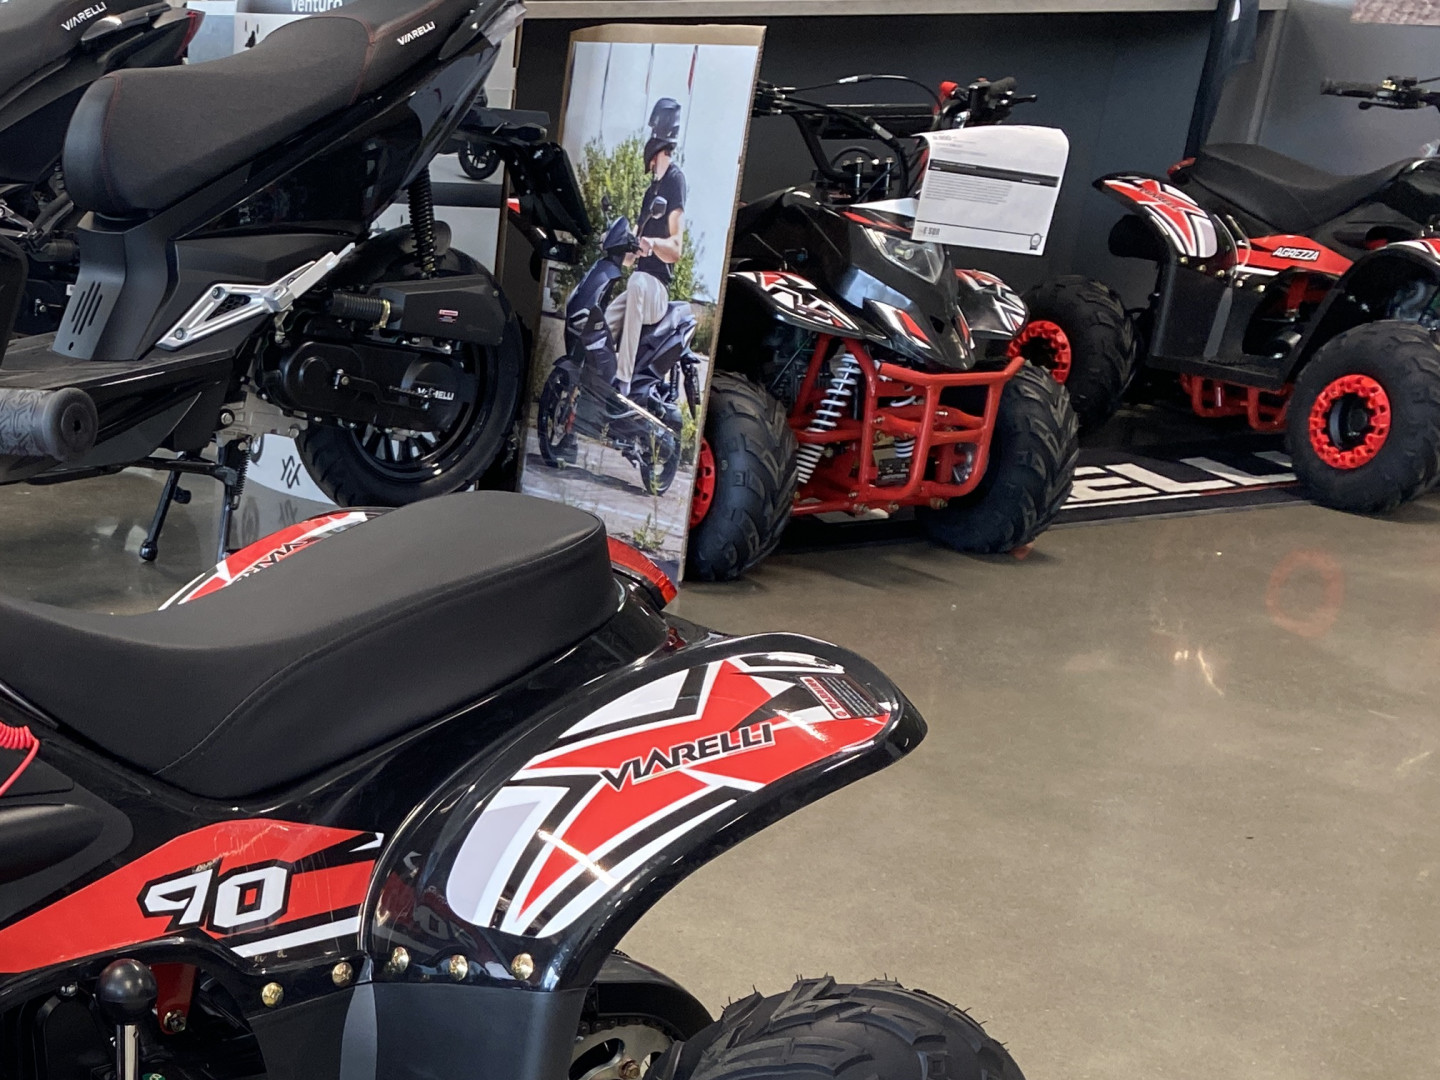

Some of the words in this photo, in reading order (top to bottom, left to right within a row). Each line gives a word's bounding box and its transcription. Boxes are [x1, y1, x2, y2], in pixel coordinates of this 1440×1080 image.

[60, 1, 108, 31] VIARELLI
[396, 20, 436, 46] VIARELLI
[1271, 246, 1320, 262] AGREZZA
[599, 722, 774, 792] VIARELLI
[141, 861, 290, 931] 90
